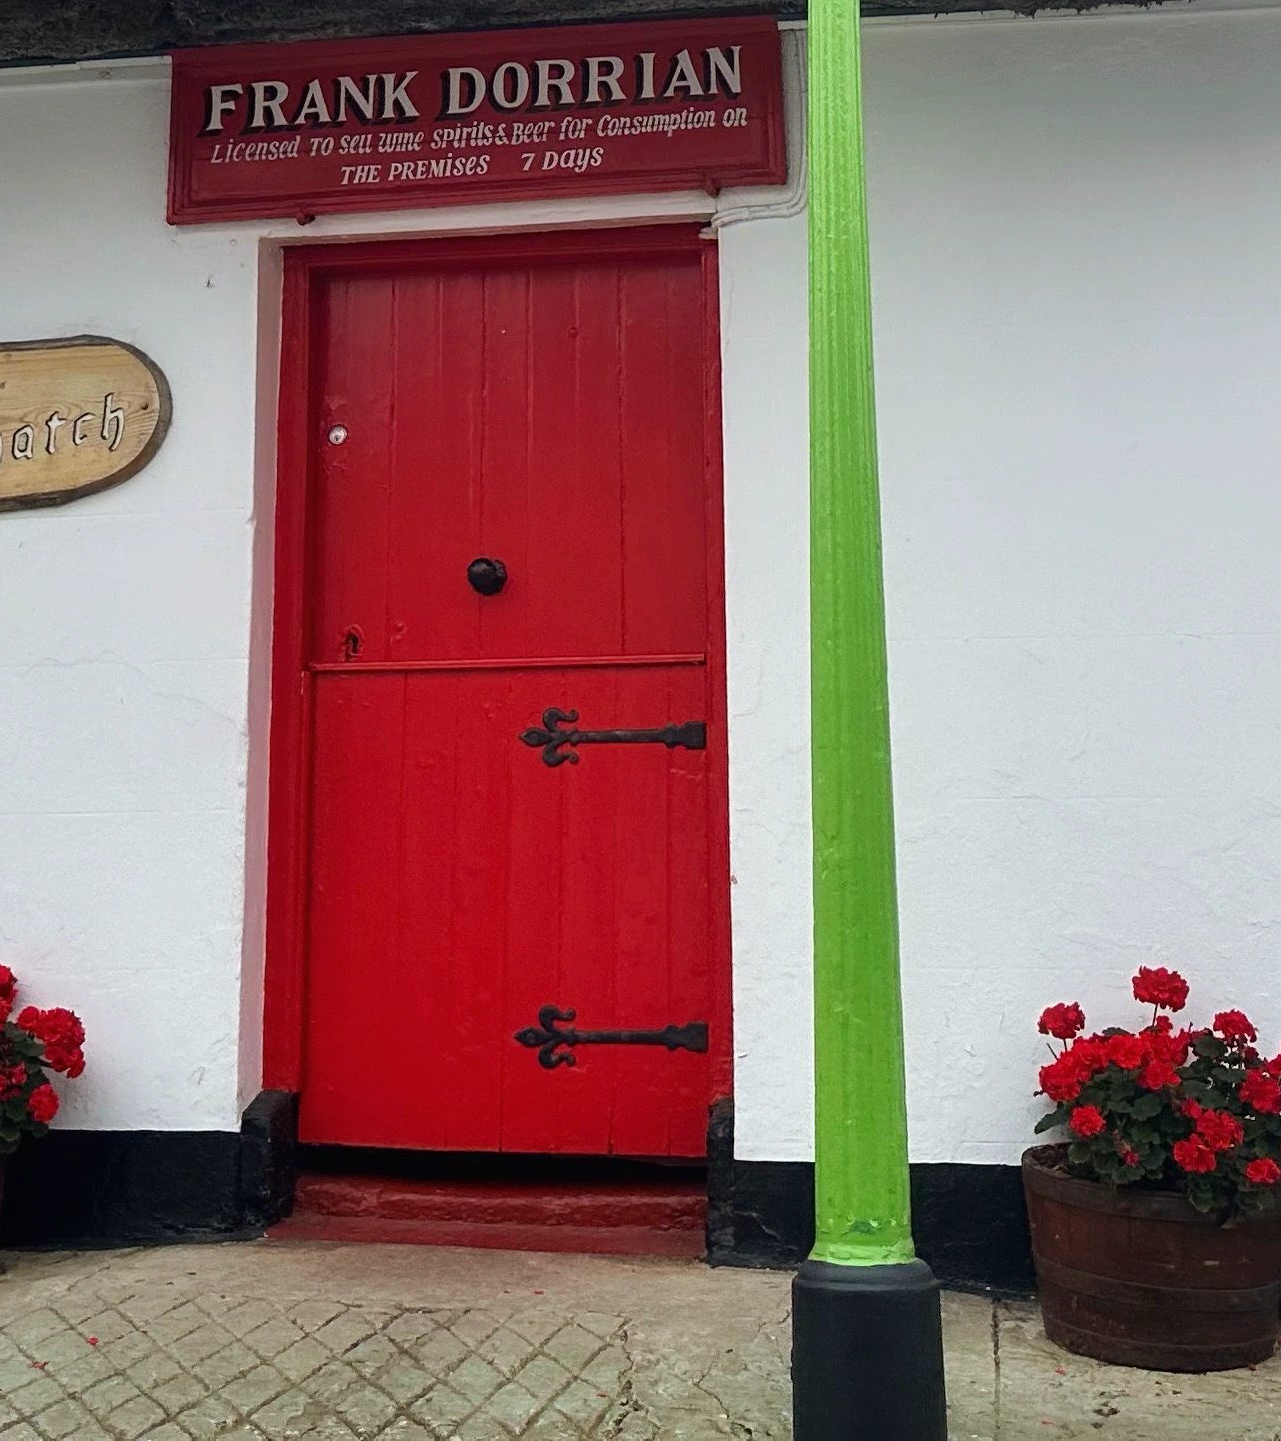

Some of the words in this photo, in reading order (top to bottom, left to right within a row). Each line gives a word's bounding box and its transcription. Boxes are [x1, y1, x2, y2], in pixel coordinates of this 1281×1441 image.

[206, 71, 420, 131] FRANK
[446, 45, 743, 115] DORRIAN
[210, 135, 301, 164] Licensed
[495, 125, 510, 146] &
[511, 120, 555, 146] Beer
[558, 115, 594, 141] for
[596, 106, 717, 138] Consumption
[722, 106, 749, 128] on
[340, 164, 383, 186] THE
[521, 152, 536, 172] 7
